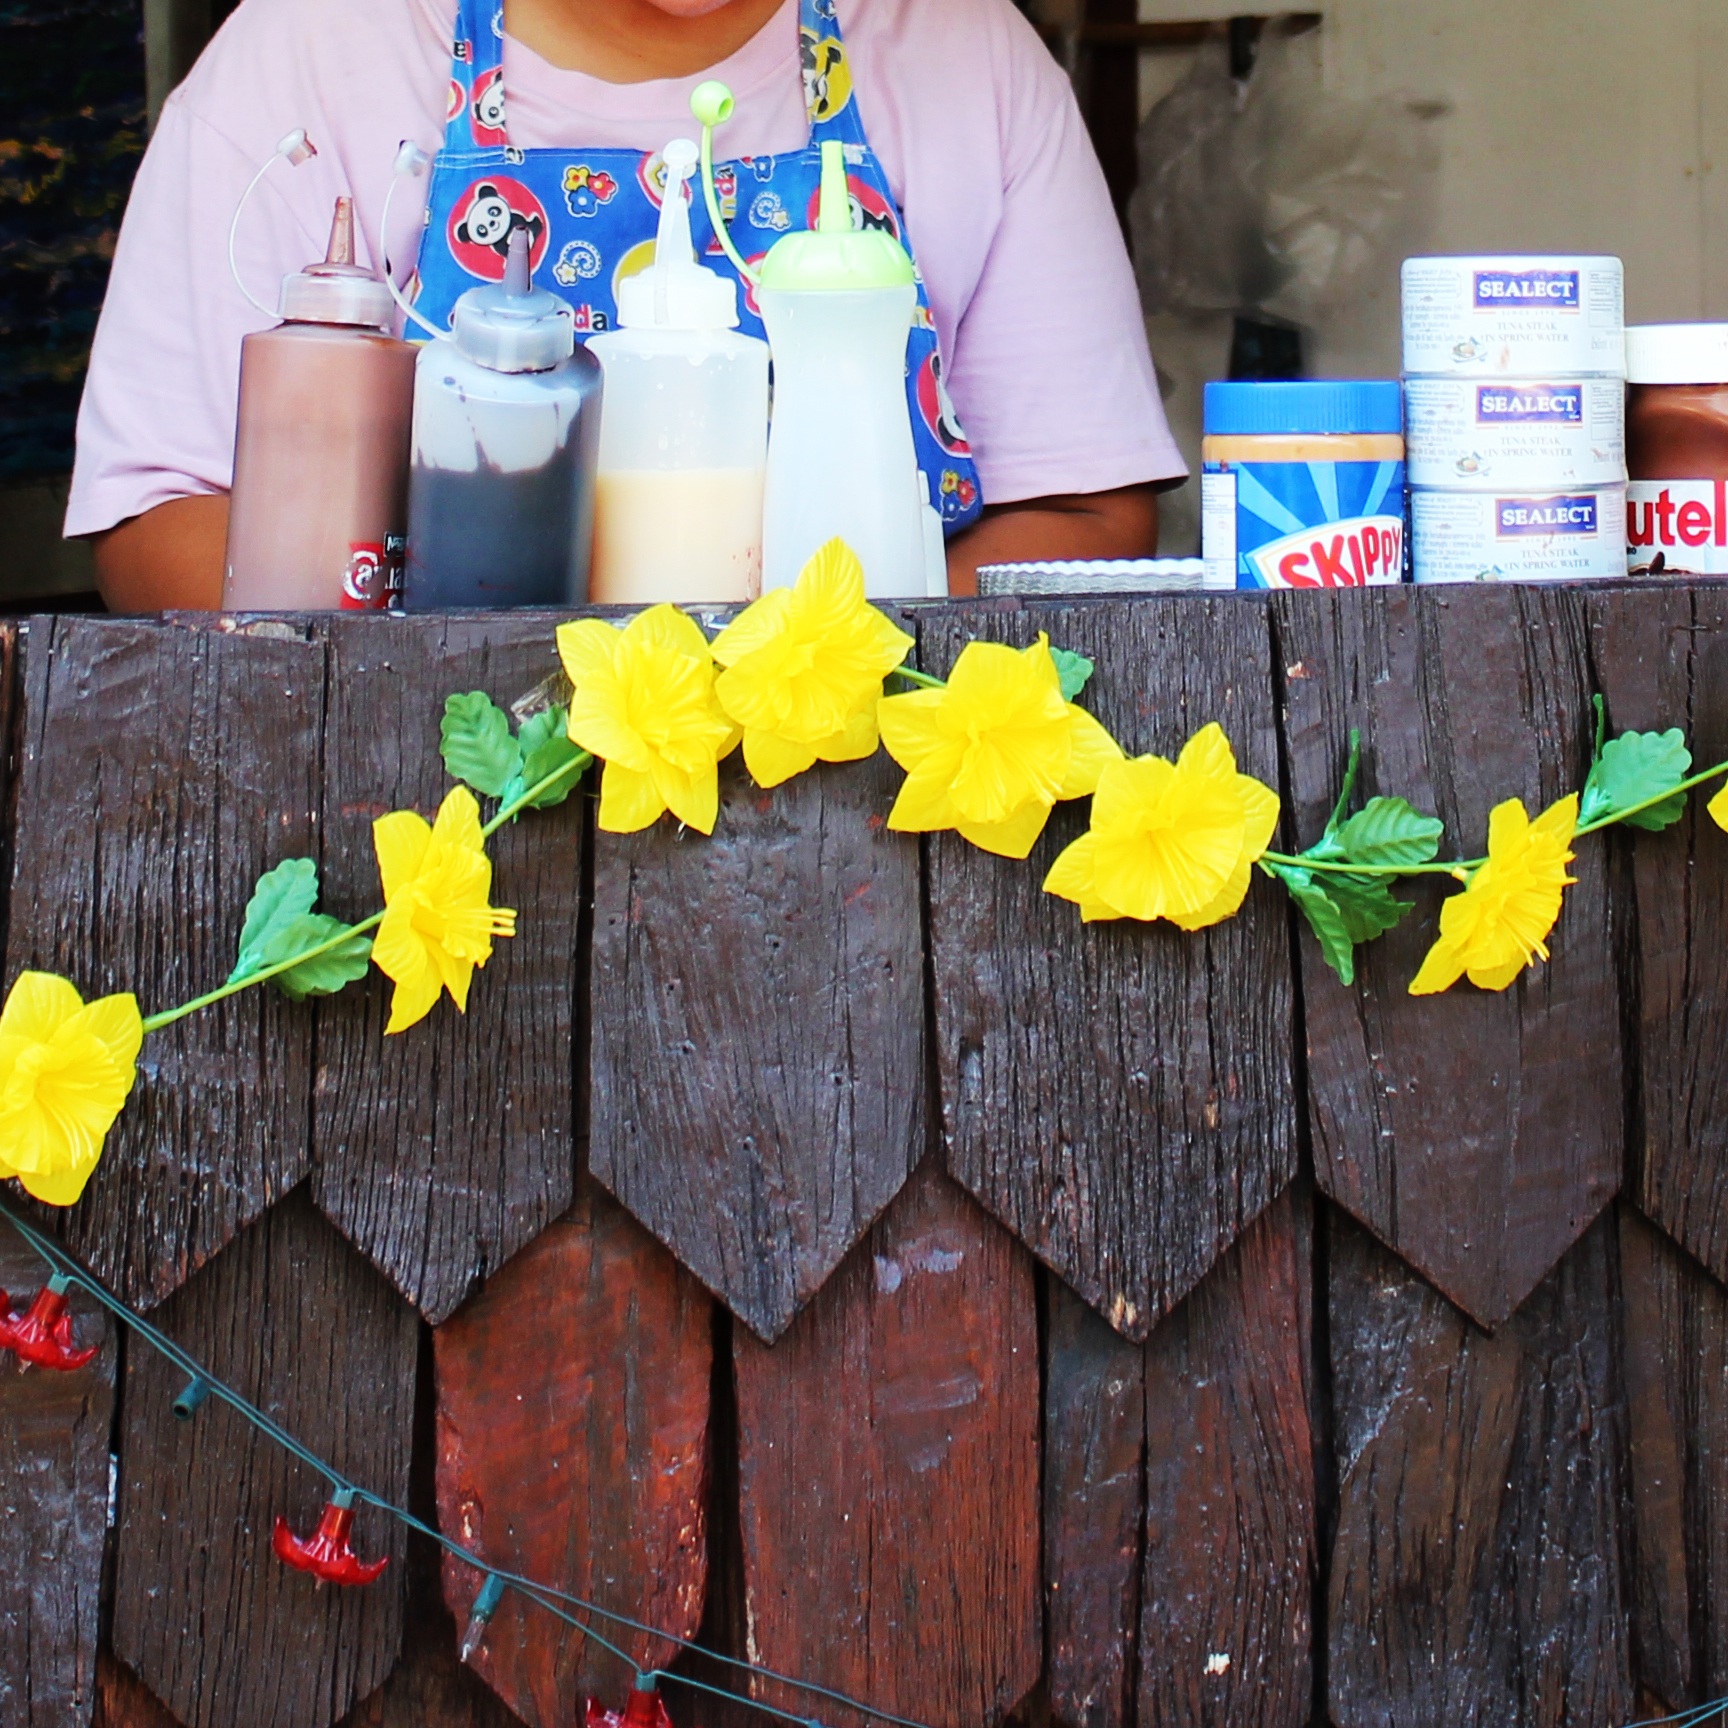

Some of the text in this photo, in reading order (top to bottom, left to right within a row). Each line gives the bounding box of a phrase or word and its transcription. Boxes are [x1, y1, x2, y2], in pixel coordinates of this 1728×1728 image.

[1479, 280, 1574, 298] SEALECT
[1497, 322, 1557, 331] TUNA STEAK
[1498, 333, 1533, 342] SPRING
[1536, 333, 1569, 342] WATER
[1482, 395, 1577, 413] SEALECT
[1501, 436, 1561, 446] TUNA STEAK
[1501, 448, 1536, 457] SPRING
[1540, 448, 1573, 457] WATER
[1502, 506, 1592, 527] SEALECT
[1279, 526, 1400, 588] SKIPPY
[1549, 548, 1579, 557] STEAK
[1522, 560, 1557, 570] SPRING
[1560, 558, 1590, 569] WATER
